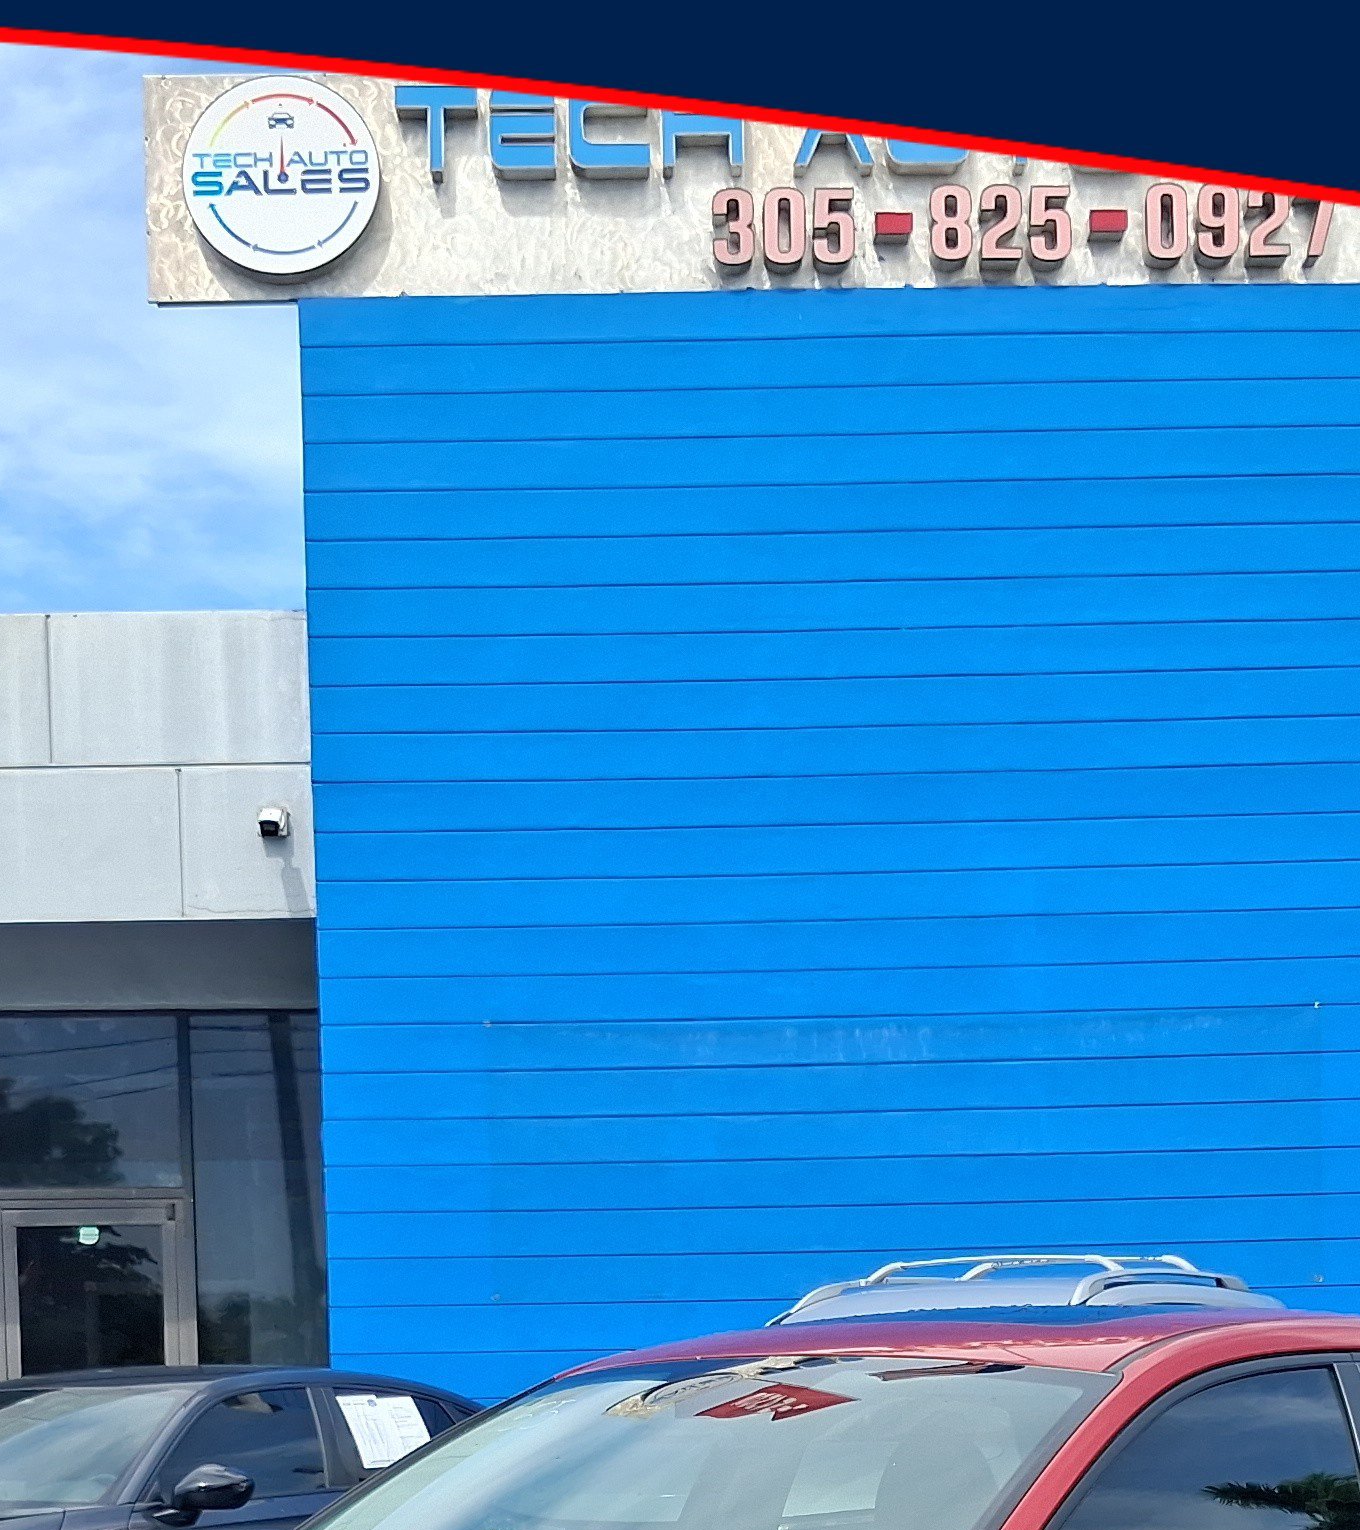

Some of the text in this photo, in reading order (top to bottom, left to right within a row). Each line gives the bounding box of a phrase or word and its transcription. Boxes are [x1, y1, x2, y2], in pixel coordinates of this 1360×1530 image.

[194, 150, 369, 168] TECH AUTO
[191, 167, 371, 196] SALES
